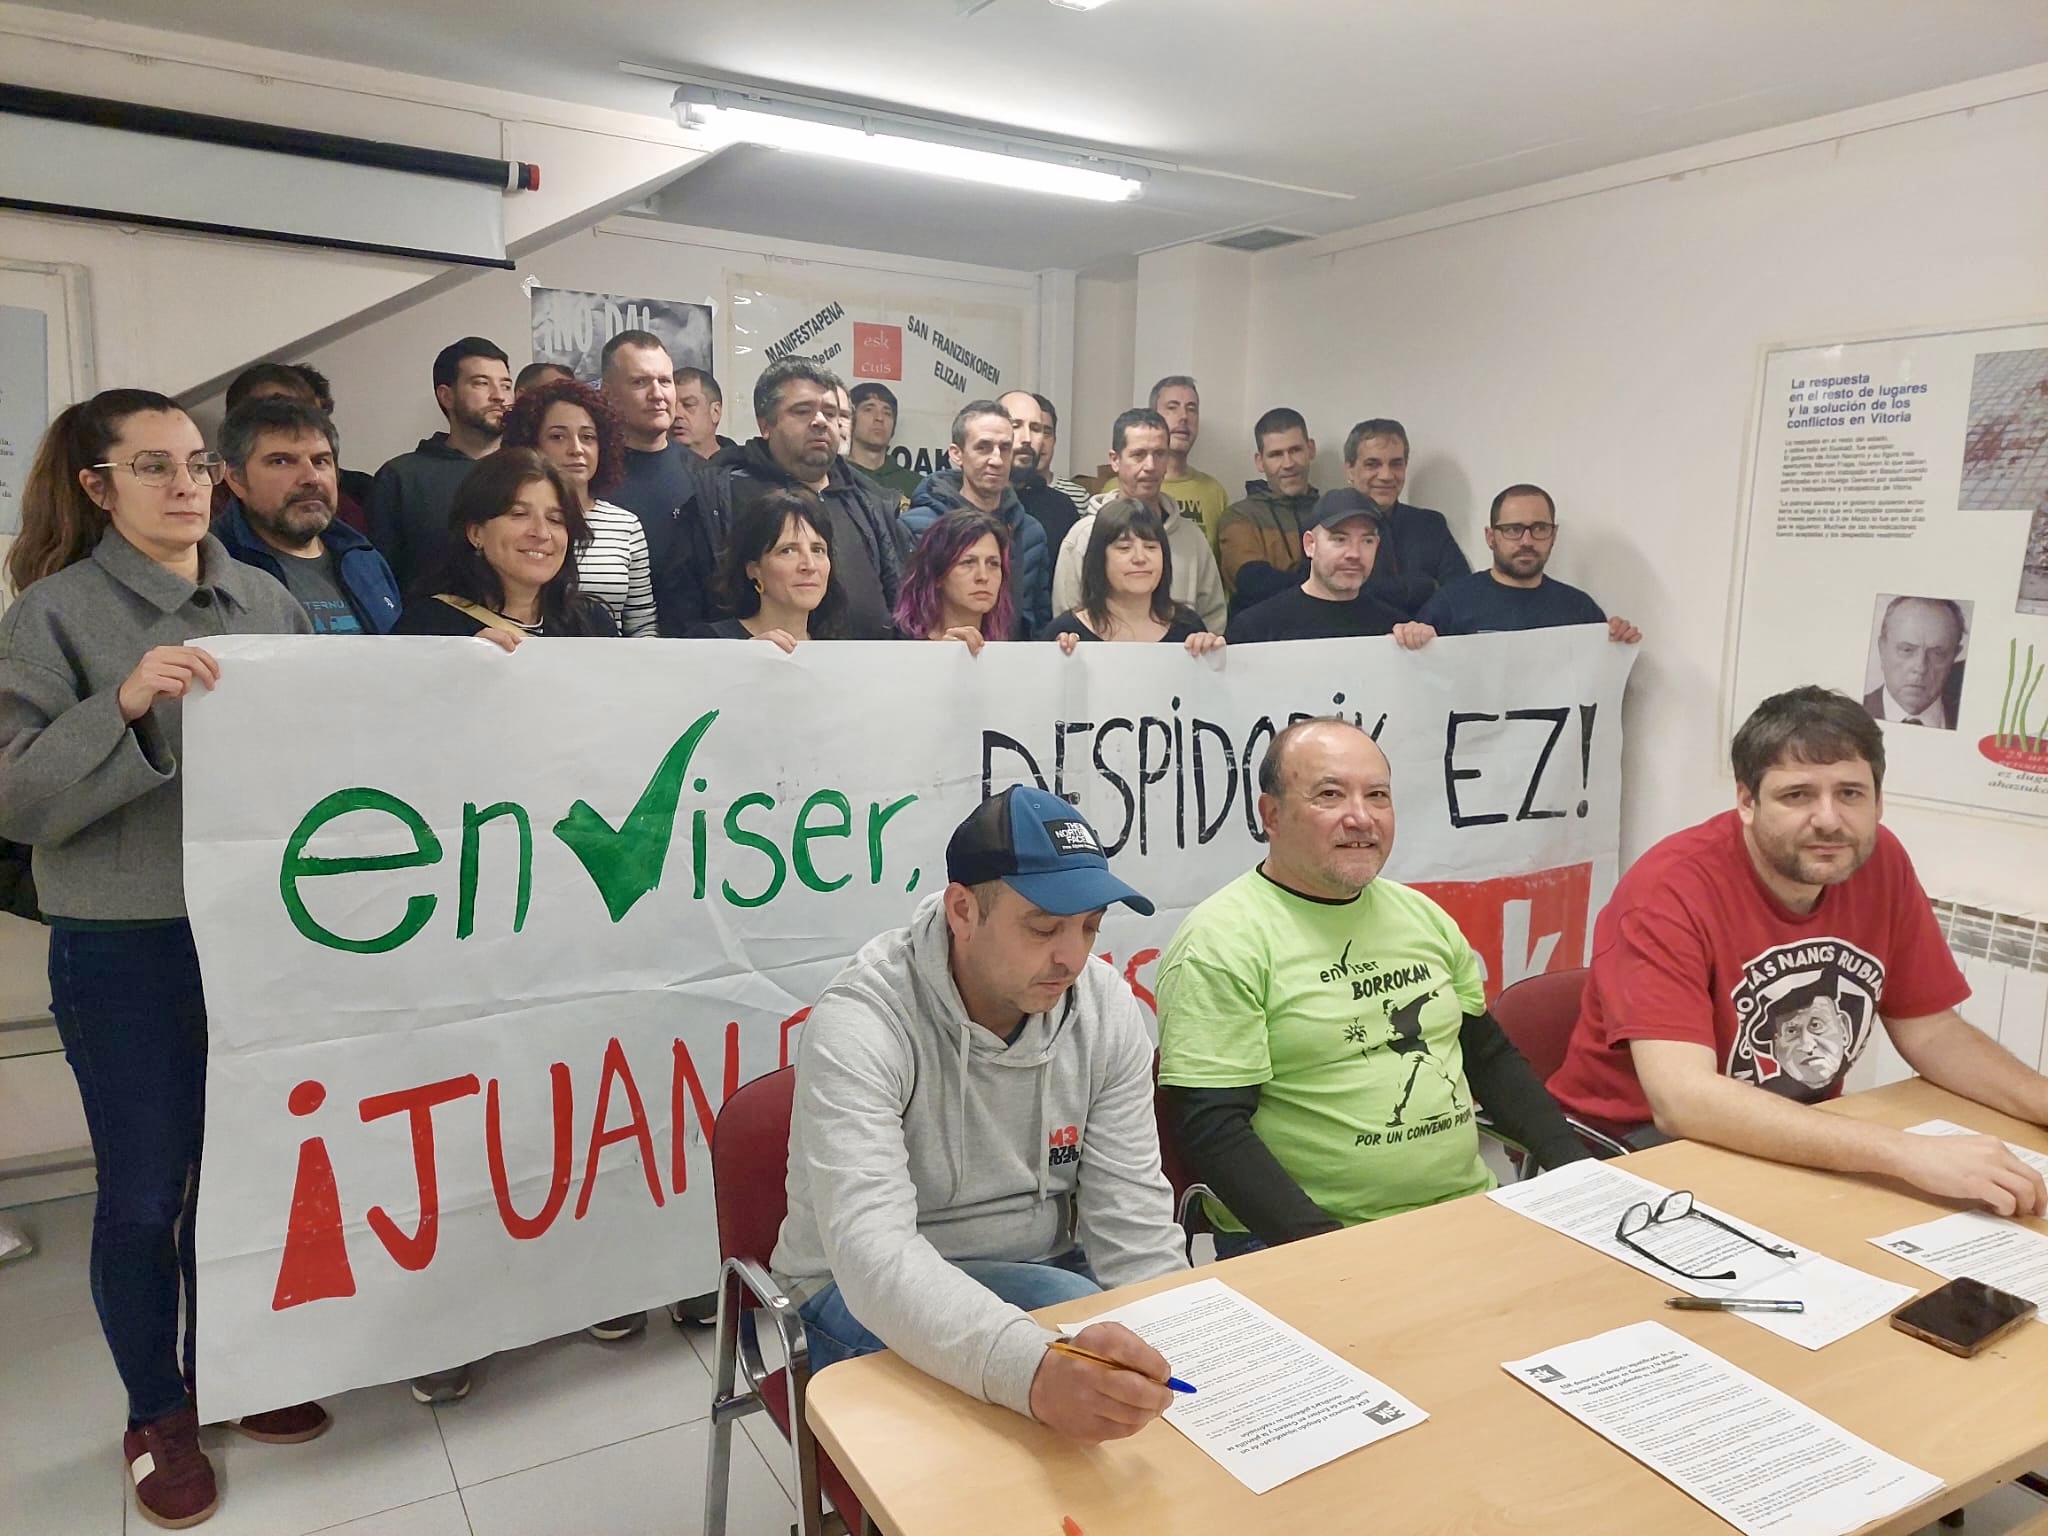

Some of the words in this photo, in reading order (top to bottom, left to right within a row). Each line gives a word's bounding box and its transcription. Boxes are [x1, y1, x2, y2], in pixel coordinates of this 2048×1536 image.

[764, 301, 845, 363] MANIFESTAPENA
[863, 329, 890, 350] esk
[907, 314, 929, 341] SAN
[931, 330, 1001, 386] FRANZISKOREN
[934, 360, 968, 394] ELIZAN
[1791, 379, 1805, 390] La
[1809, 373, 1870, 390] respuesta
[1789, 393, 1804, 403] en
[1807, 390, 1818, 401] el
[1822, 388, 1854, 401] resto
[1858, 386, 1874, 398] de
[1878, 383, 1928, 399] lugares
[1788, 406, 1795, 418] y
[1799, 404, 1809, 415] la
[1870, 398, 1887, 411] de
[1891, 396, 1911, 409] los
[1787, 415, 1846, 429] conflictos
[1849, 415, 1866, 426] en
[1870, 411, 1912, 424] Vitoria
[303, 600, 350, 610] TERNU
[982, 691, 1388, 858] DESPIDO
[1445, 702, 1598, 828] EZ!
[1054, 829, 1086, 838] NORTH
[1066, 835, 1088, 844] FACE
[1351, 963, 1432, 1001] BORROKAN
[1355, 1132, 1381, 1147] POR
[1386, 1129, 1403, 1145] UN
[1407, 1118, 1453, 1142] CONVENIO
